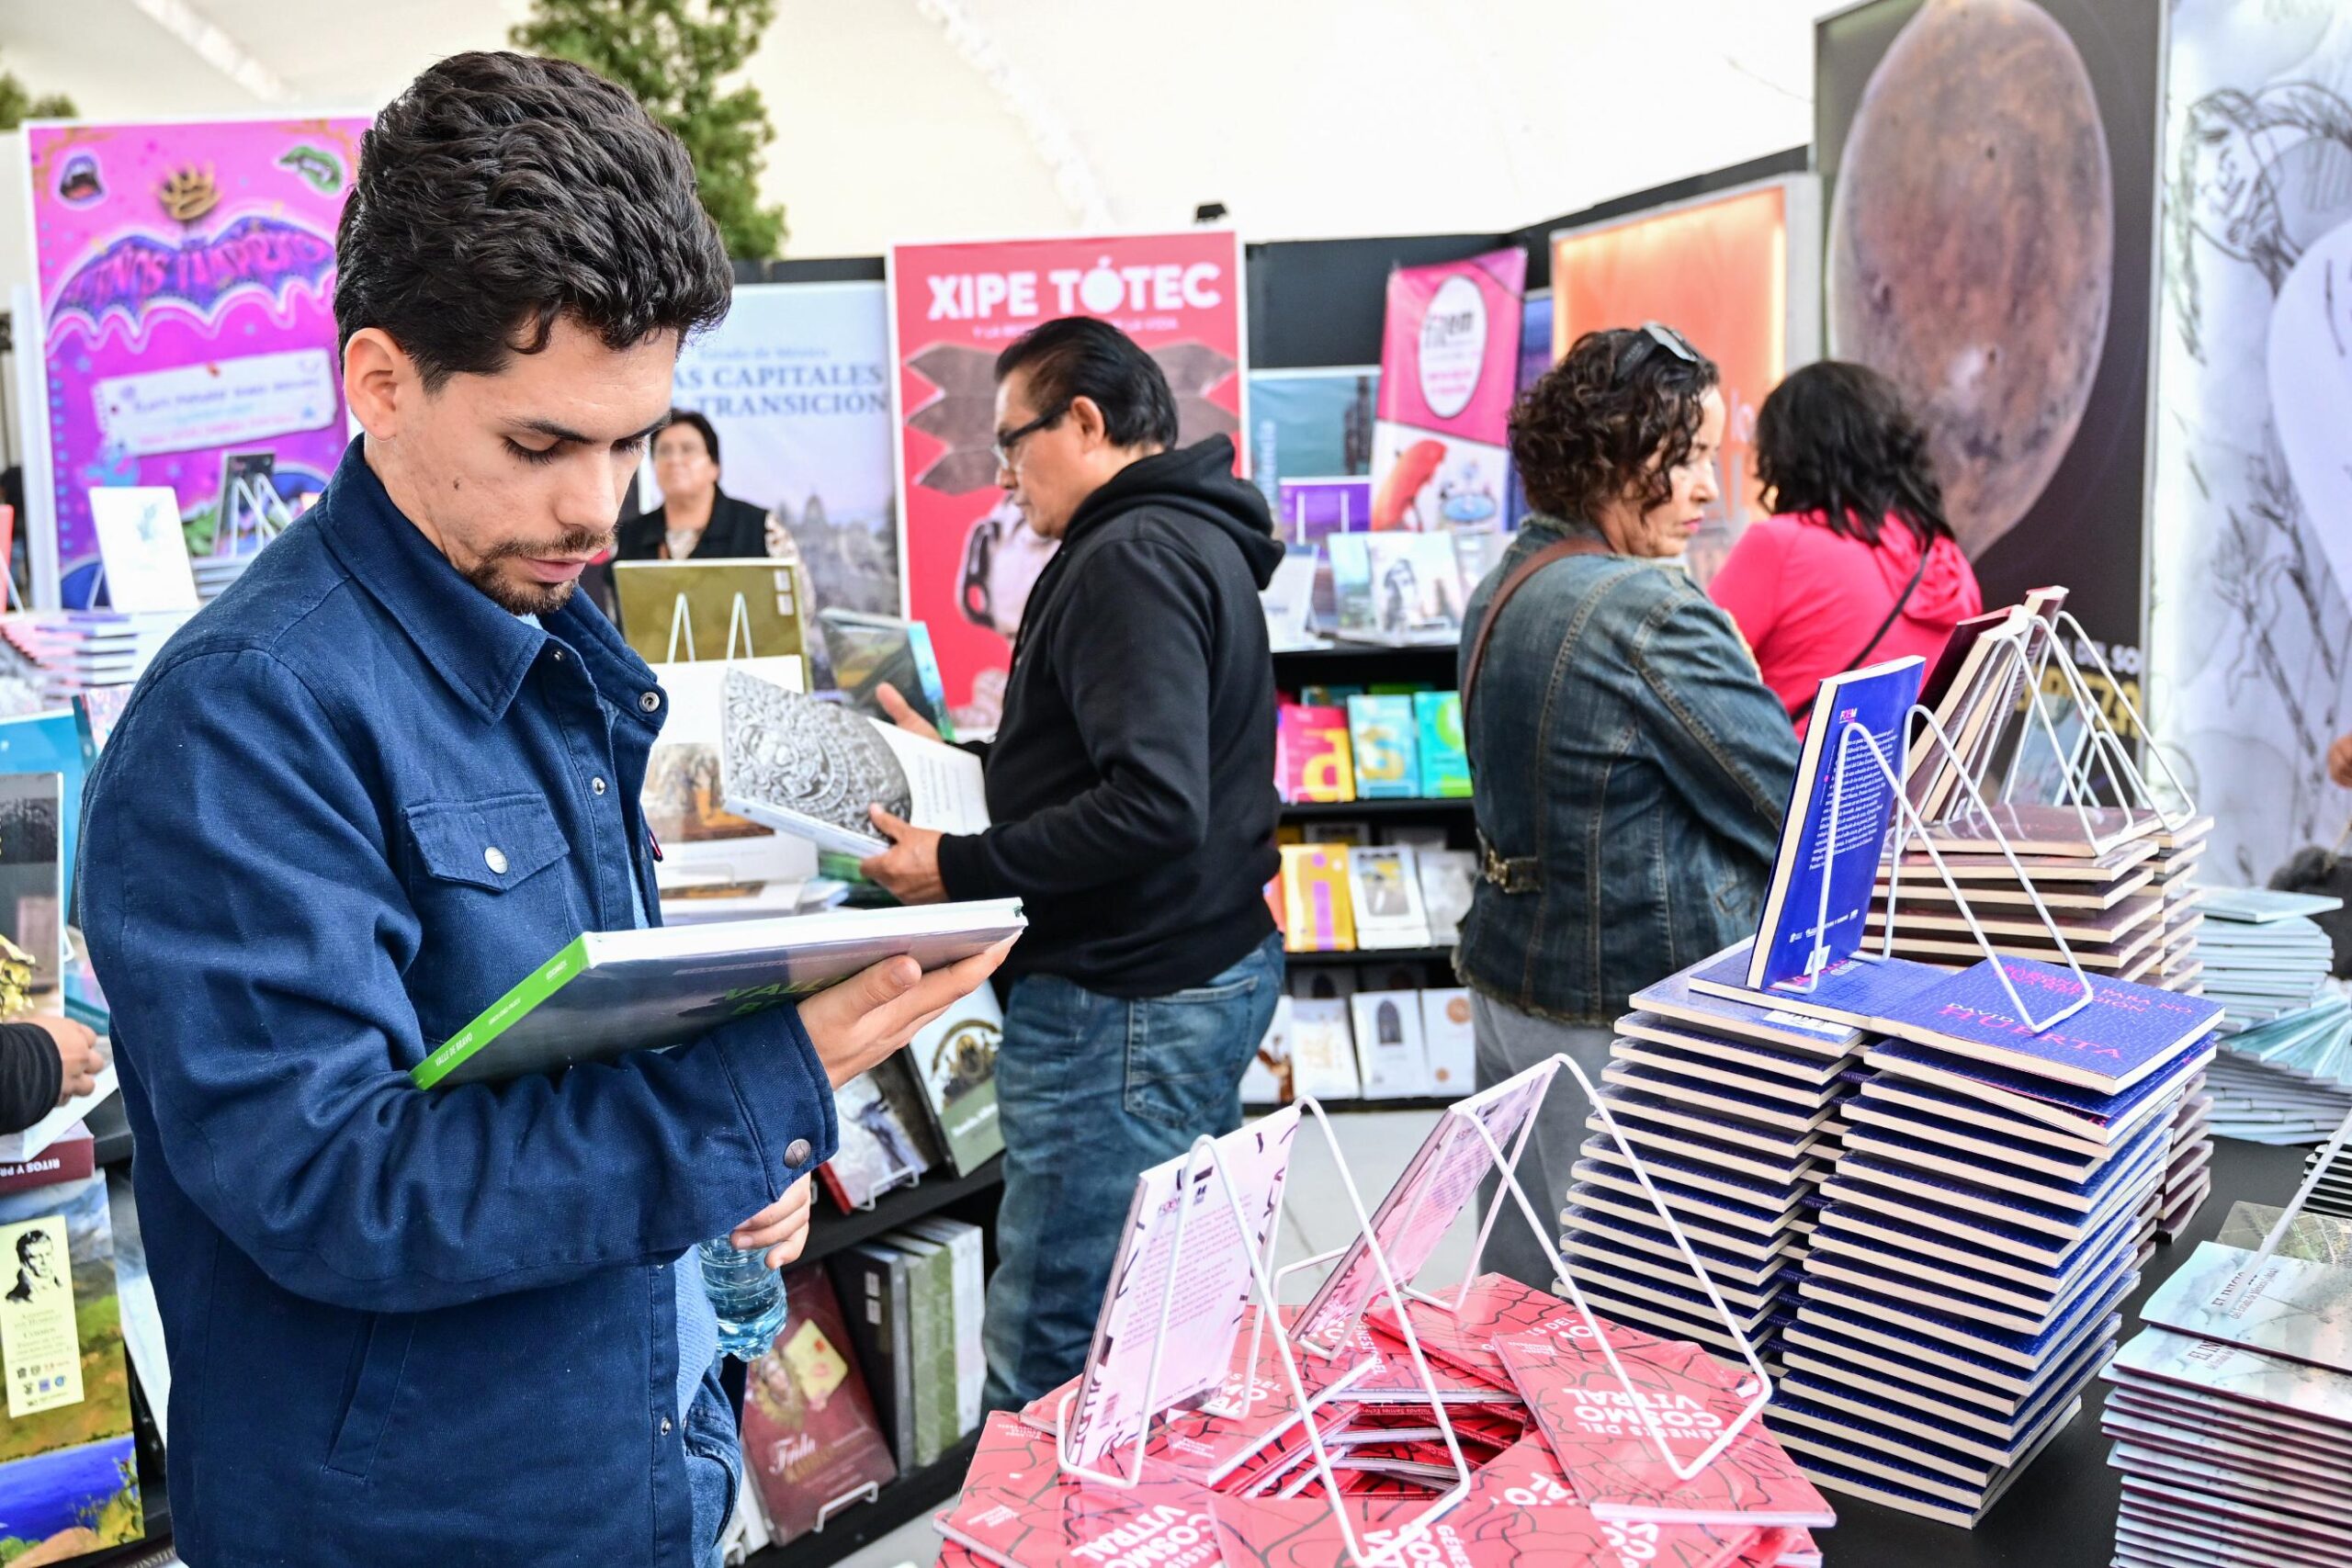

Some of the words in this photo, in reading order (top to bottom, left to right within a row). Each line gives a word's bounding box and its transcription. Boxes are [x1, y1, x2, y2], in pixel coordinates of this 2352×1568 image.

[926, 271, 1039, 321] XIPE
[1047, 255, 1222, 314] TÓTEC
[673, 370, 703, 389] AS
[713, 364, 884, 389] CAPITALES
[696, 389, 888, 418] TRANSICIÓN
[724, 976, 847, 1000] VALL
[2101, 988, 2151, 1006] PARA
[1948, 1002, 2015, 1023] DAVID
[1938, 1006, 2121, 1059] HUERTA
[435, 1049, 451, 1066] VALLE
[456, 1032, 473, 1052] BRAVO
[17, 1165, 25, 1175] Y
[27, 1157, 60, 1173] RITOS
[1544, 1317, 1577, 1330] DEL
[1562, 1389, 1703, 1410] VITRAL
[1573, 1405, 1723, 1427] COSMO
[1577, 1423, 1623, 1435] DEL
[1070, 1505, 1187, 1561] VITRAL
